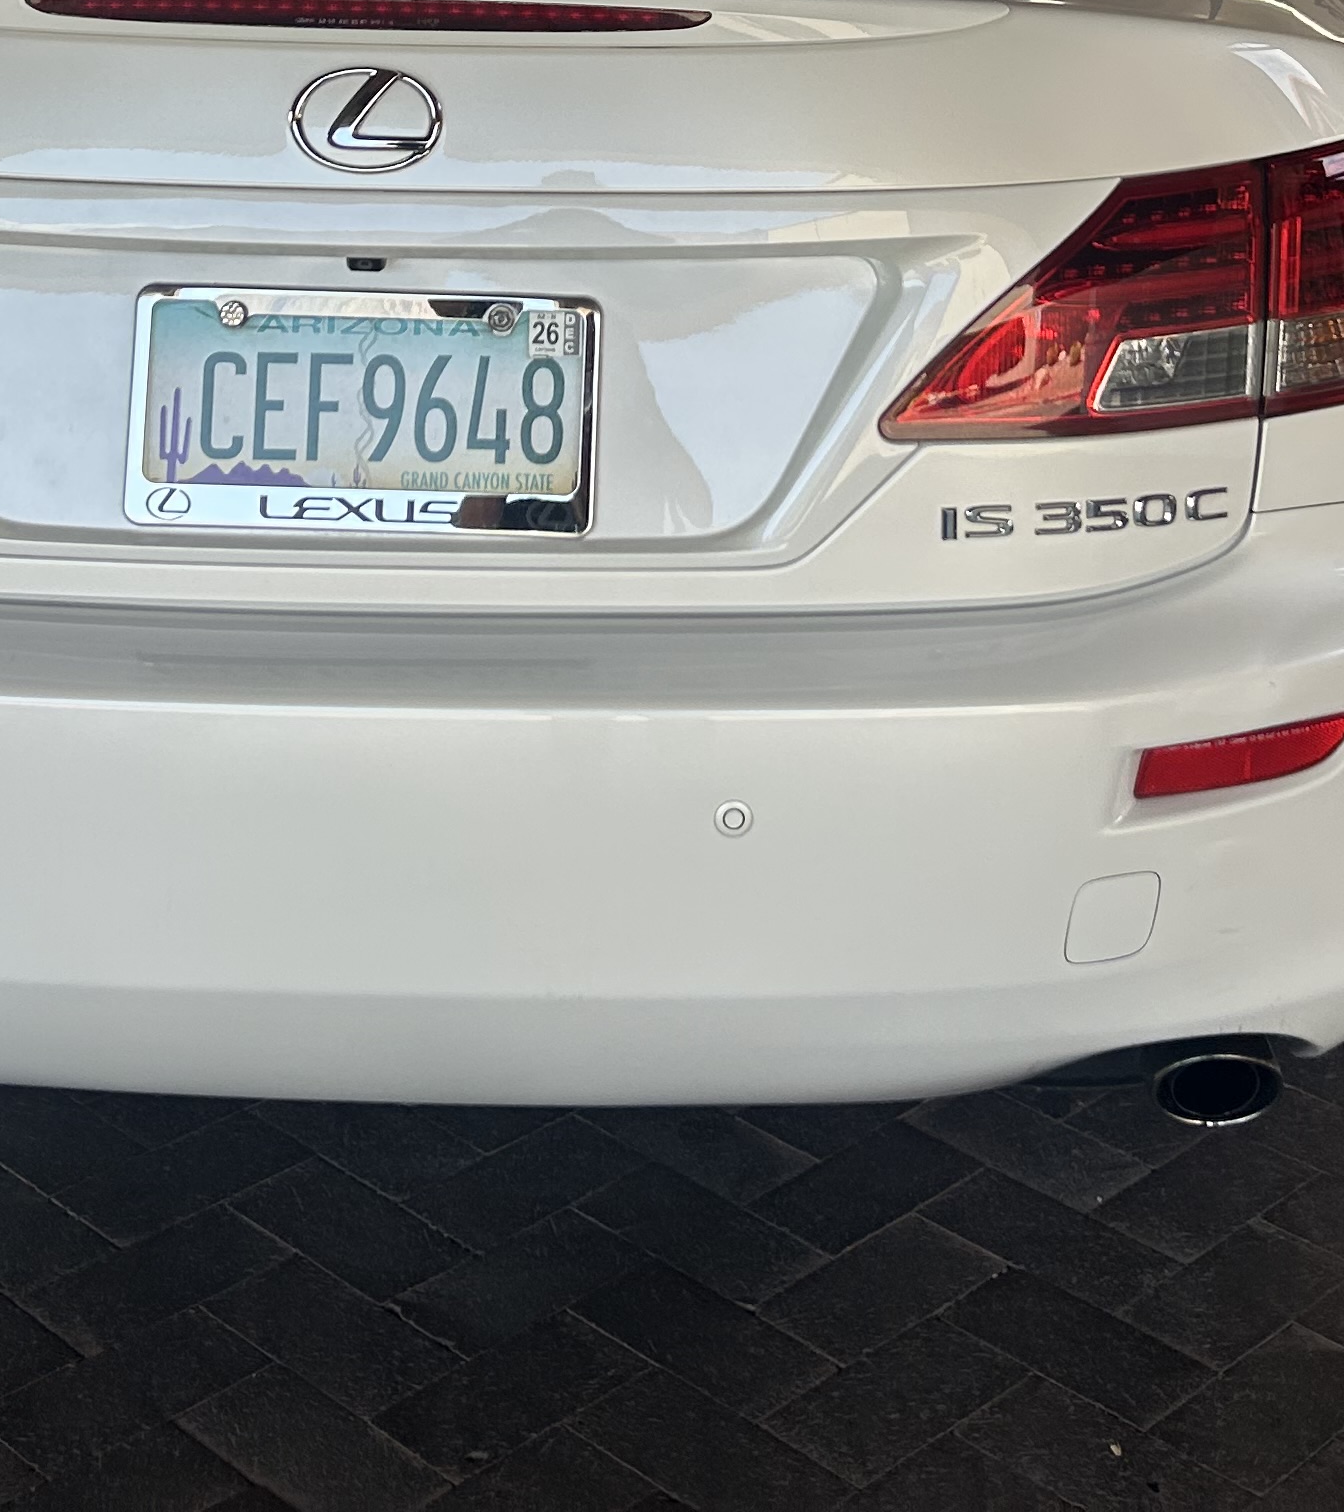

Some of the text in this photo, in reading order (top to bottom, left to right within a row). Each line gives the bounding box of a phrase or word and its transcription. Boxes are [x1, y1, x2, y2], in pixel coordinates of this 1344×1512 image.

[257, 314, 481, 337] ARIZONA
[532, 320, 559, 345] 26
[199, 350, 565, 466] CEF9648
[401, 471, 554, 491] GRAND CANYON STATE
[259, 494, 459, 524] LEXUS
[941, 504, 1015, 541] IS
